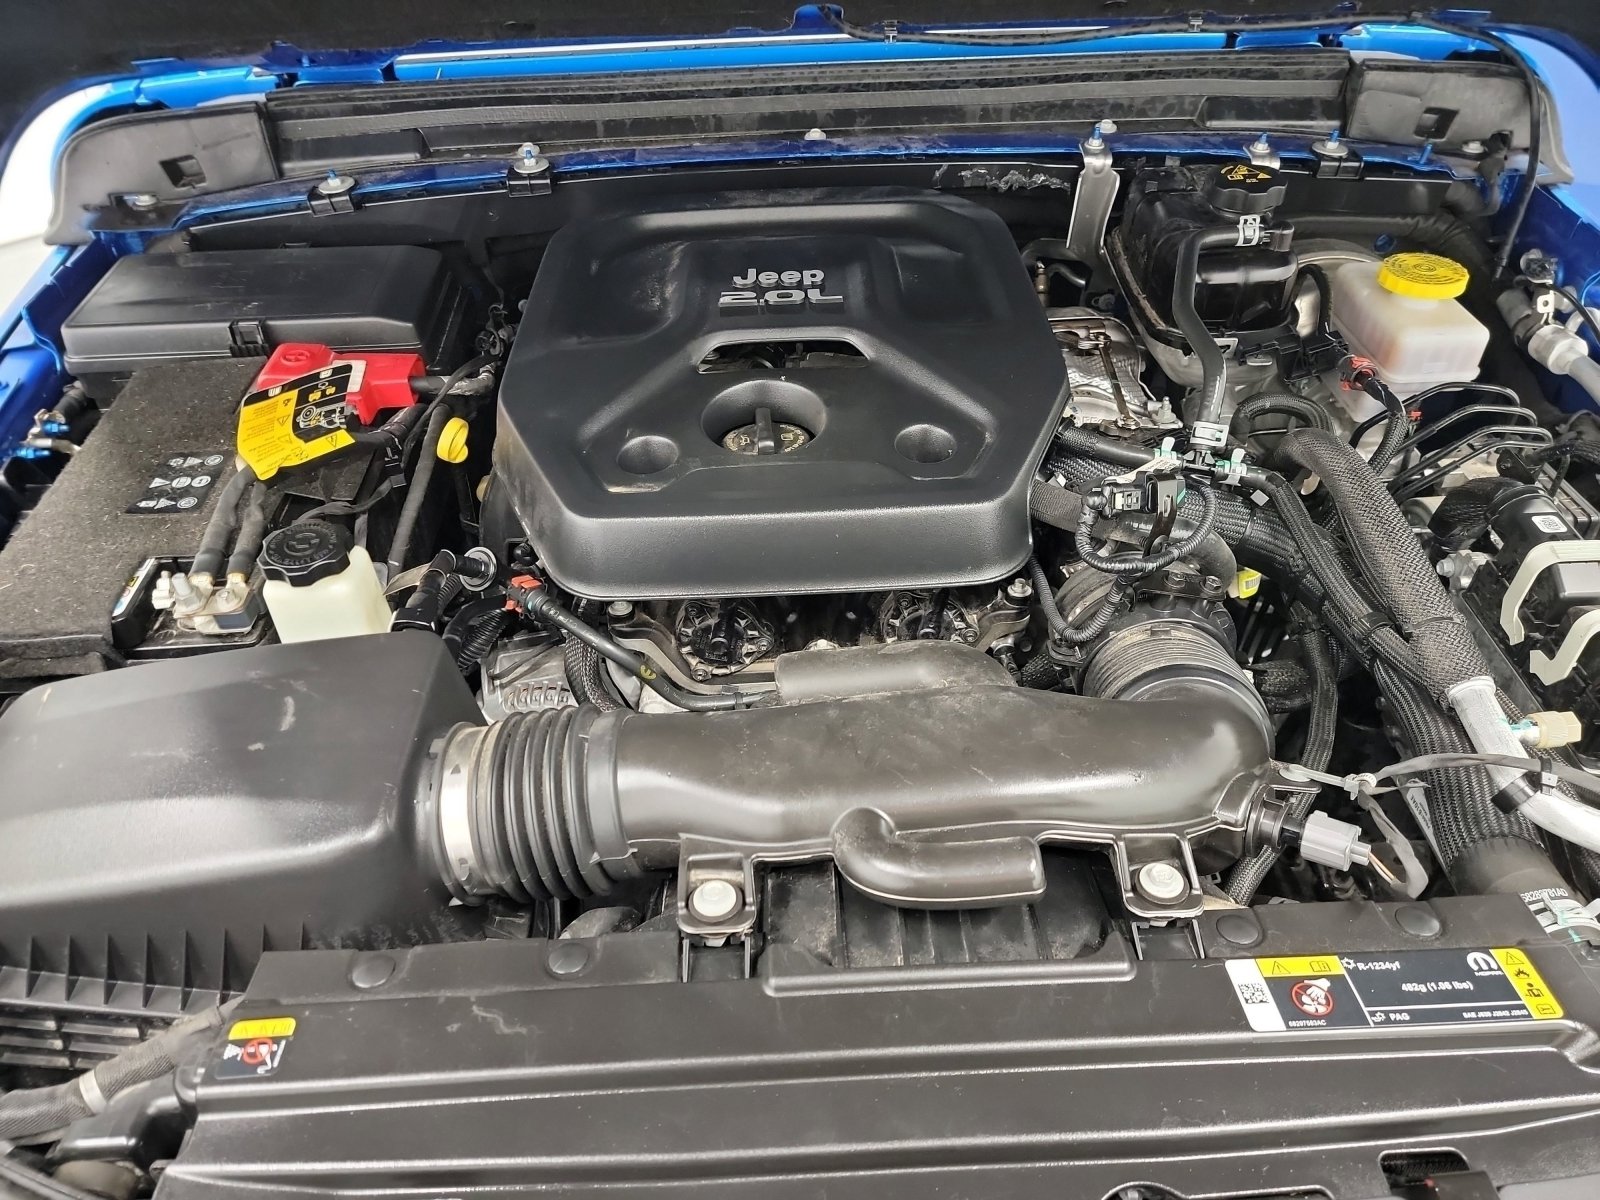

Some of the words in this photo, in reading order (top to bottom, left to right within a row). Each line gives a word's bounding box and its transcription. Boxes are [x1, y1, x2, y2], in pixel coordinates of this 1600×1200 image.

[733, 268, 825, 287] Jeep
[718, 288, 844, 306] 2.0L
[1357, 961, 1401, 971] R-1234yf
[1401, 982, 1427, 993] 482g
[1453, 980, 1474, 991] lbs)
[1389, 1012, 1411, 1021] PAG
